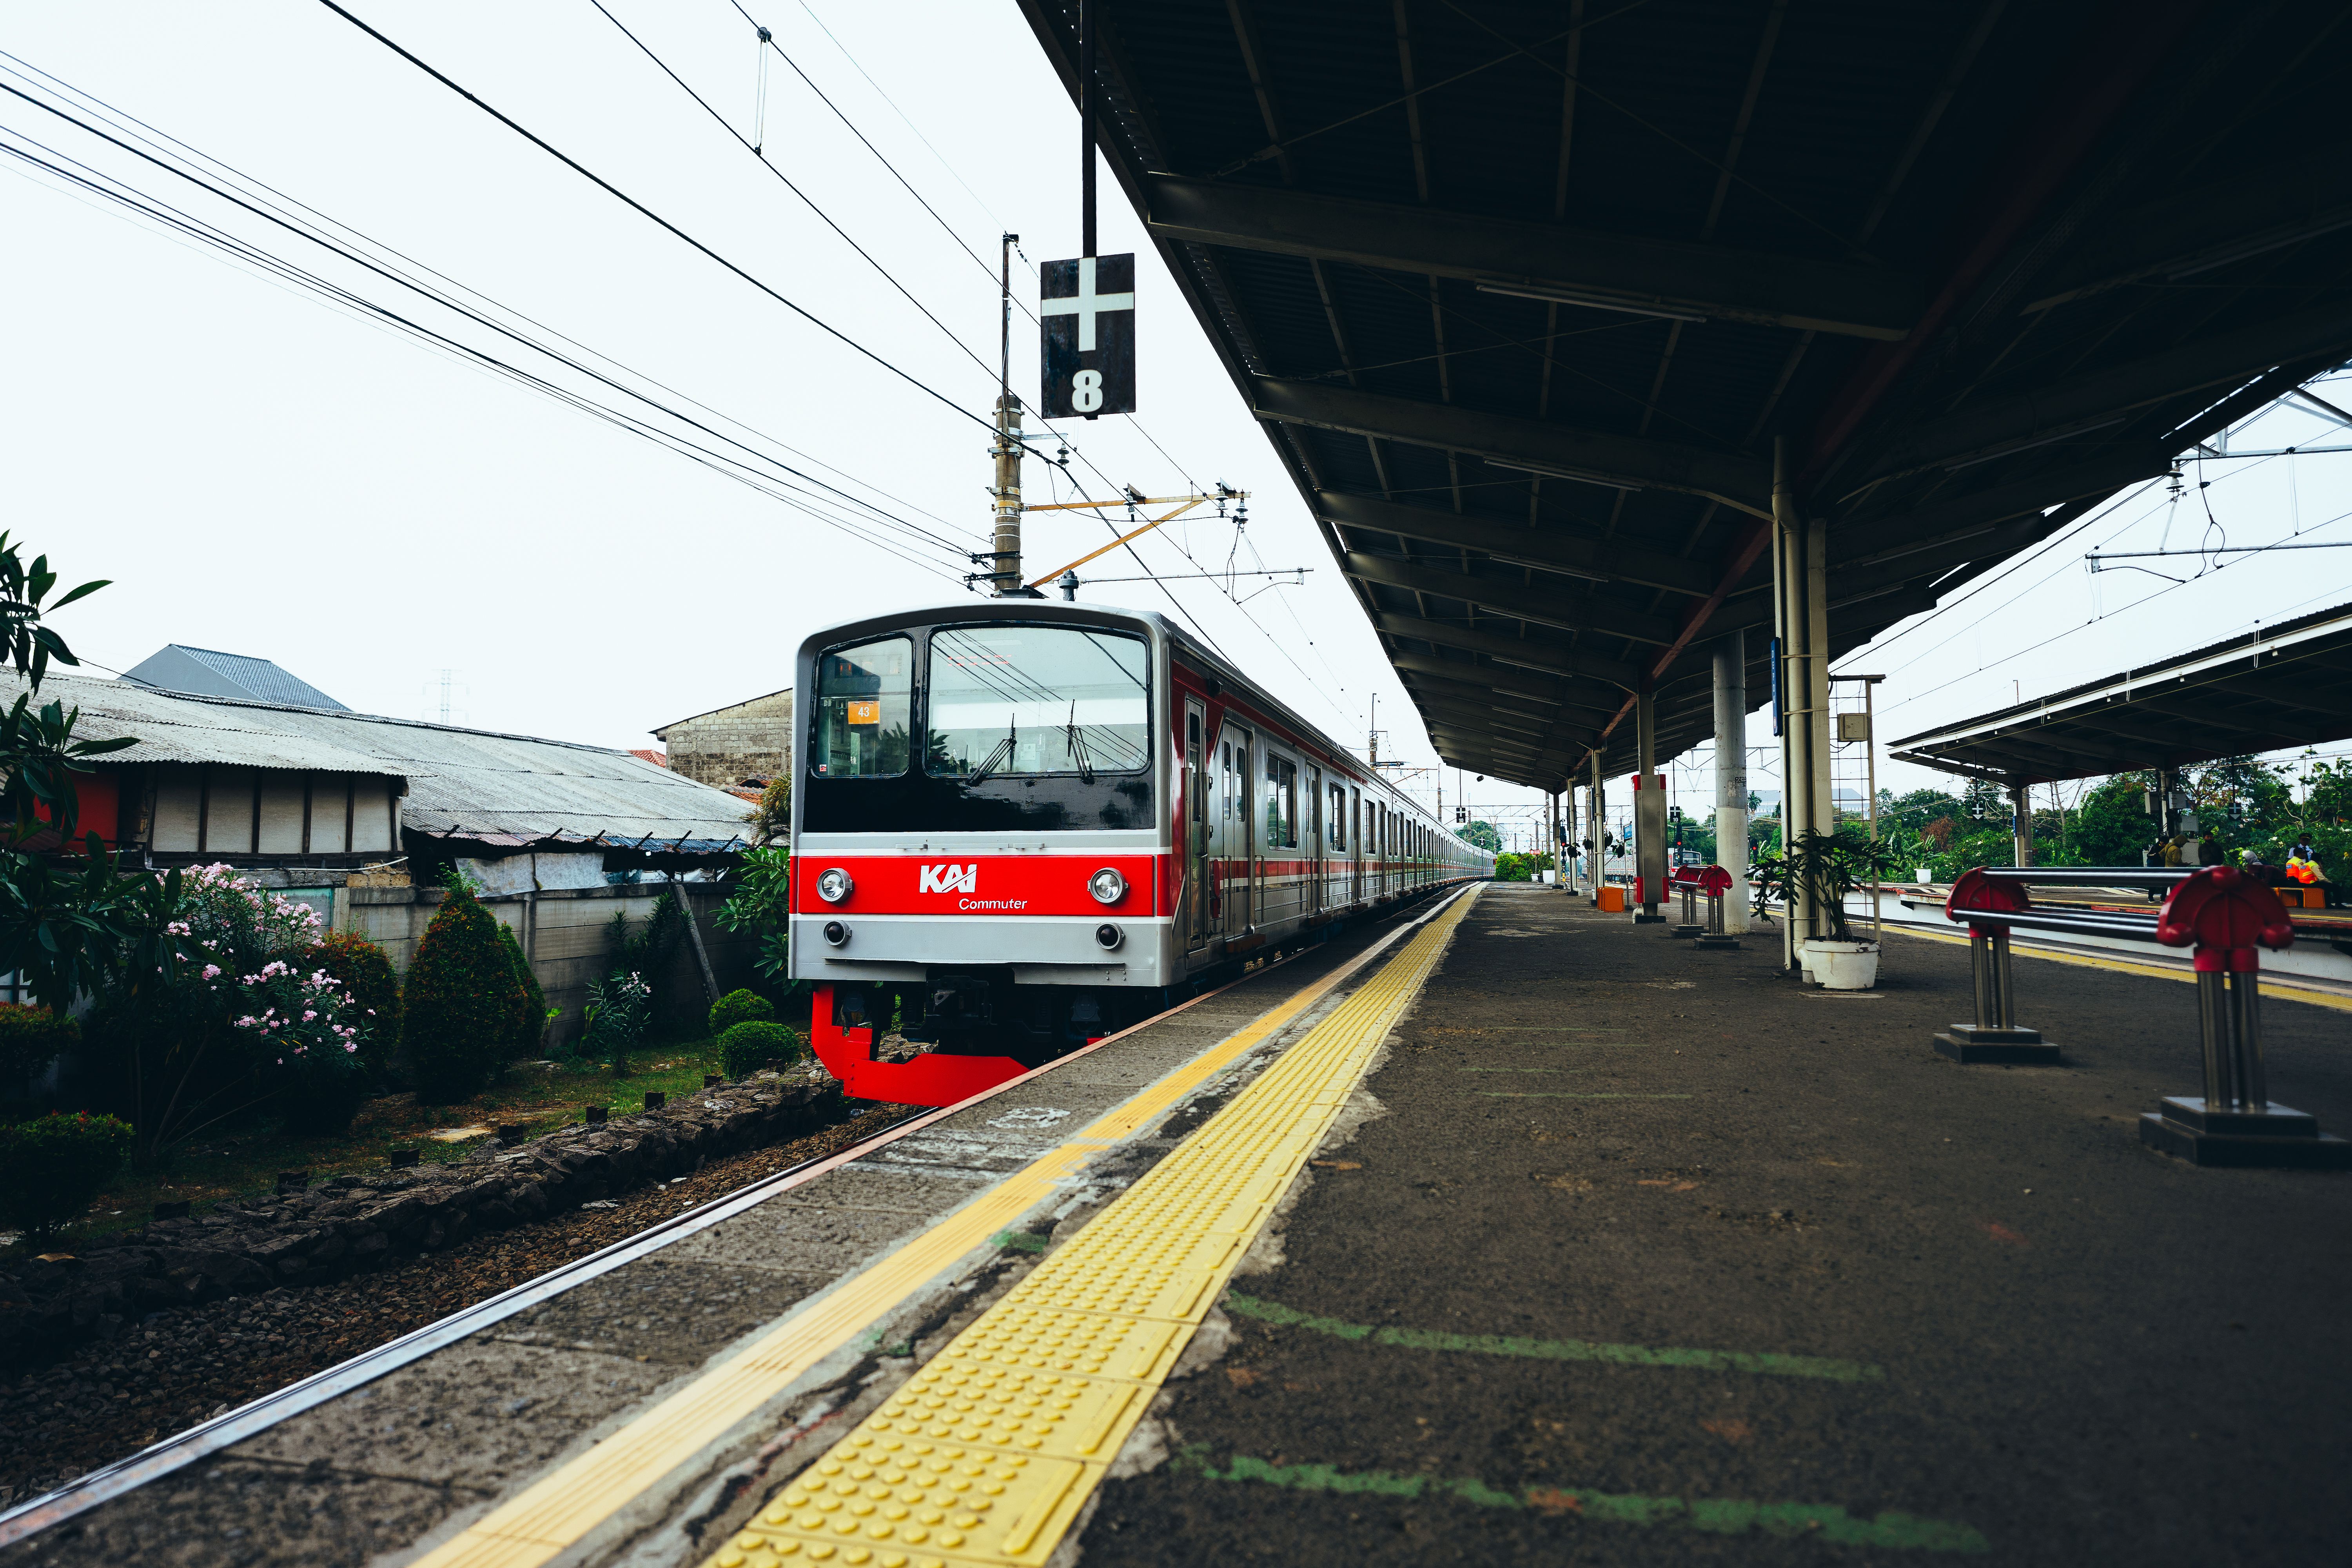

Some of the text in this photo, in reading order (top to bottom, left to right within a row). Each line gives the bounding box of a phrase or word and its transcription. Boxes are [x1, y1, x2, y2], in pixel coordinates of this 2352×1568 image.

[1072, 369, 1103, 412] 8
[858, 706, 869, 717] 43
[920, 864, 977, 893] KAI
[959, 898, 1027, 910] Commuter
